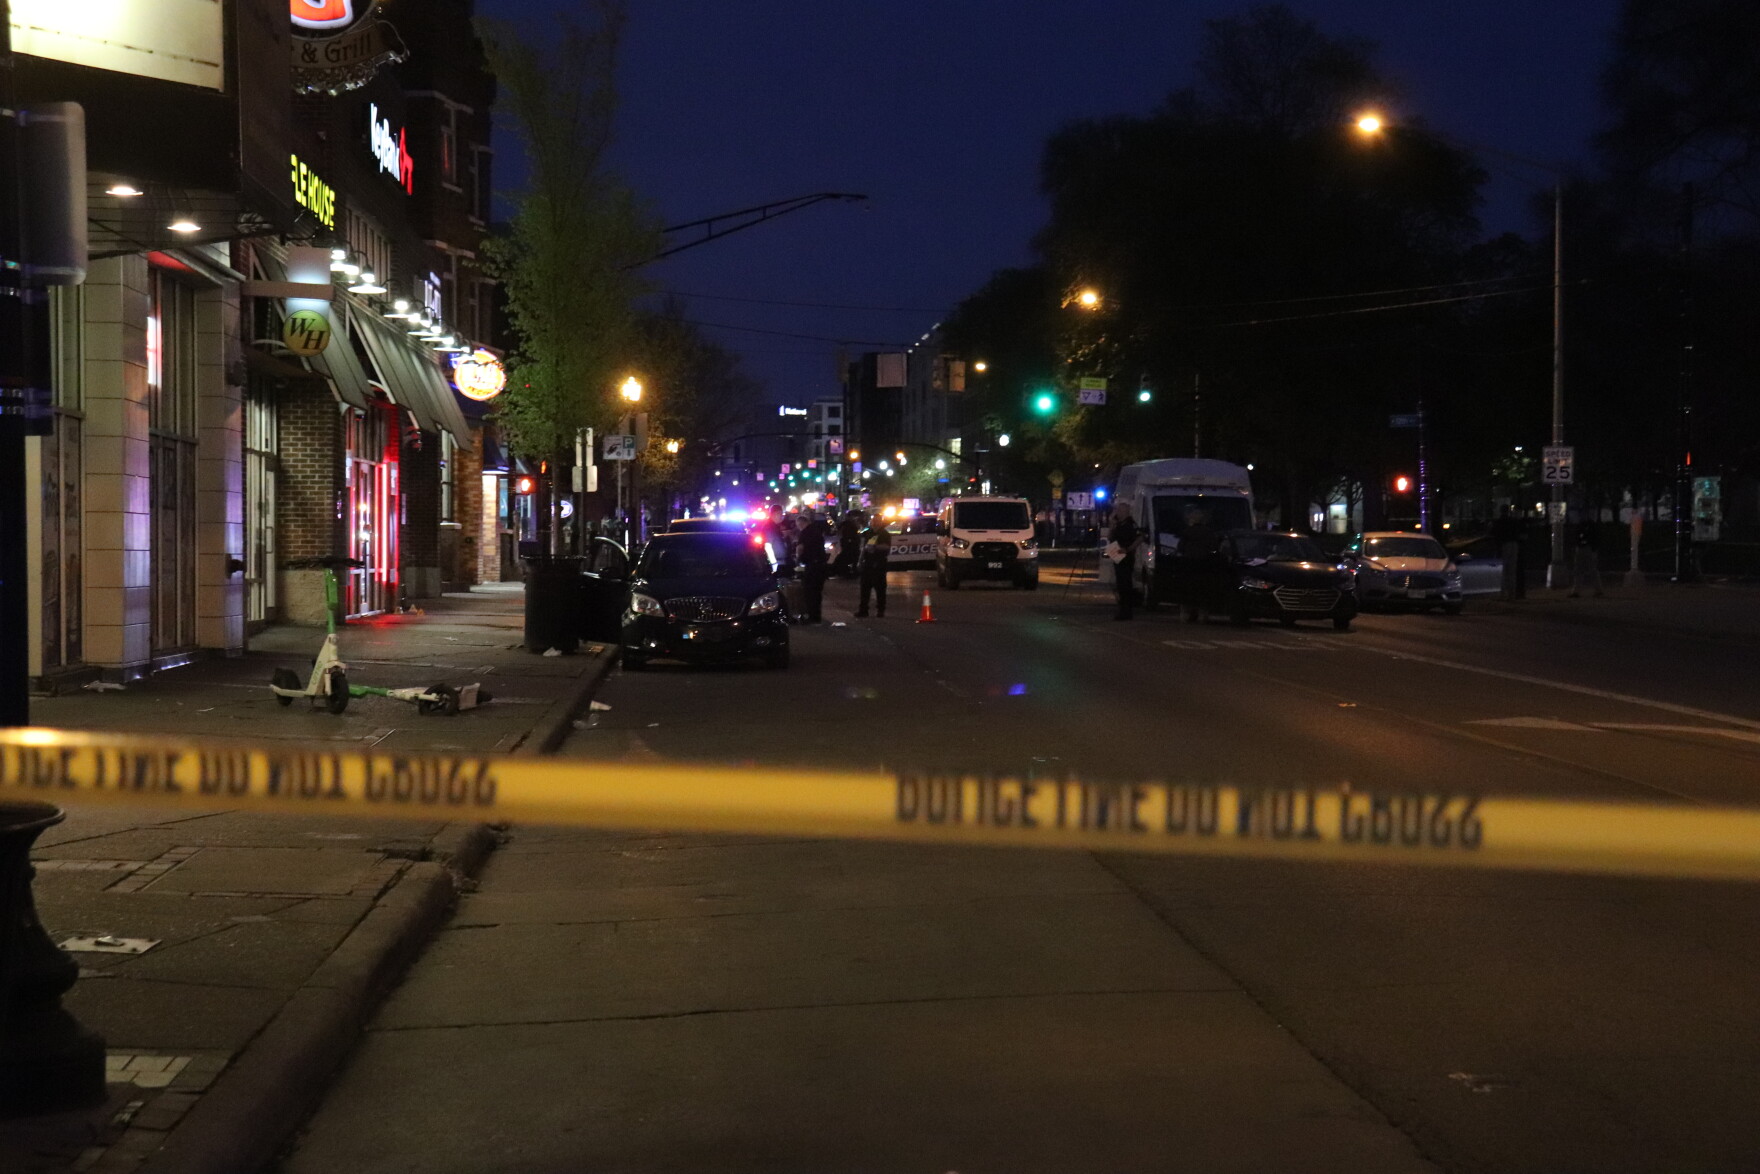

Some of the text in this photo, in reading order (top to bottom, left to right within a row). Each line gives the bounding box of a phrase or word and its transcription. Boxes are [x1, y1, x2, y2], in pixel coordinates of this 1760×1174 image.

[301, 33, 372, 63] & Grill
[307, 169, 336, 228] HOUSE
[1546, 450, 1571, 458] SPEED
[1546, 466, 1570, 480] 25
[889, 544, 938, 555] POLICE
